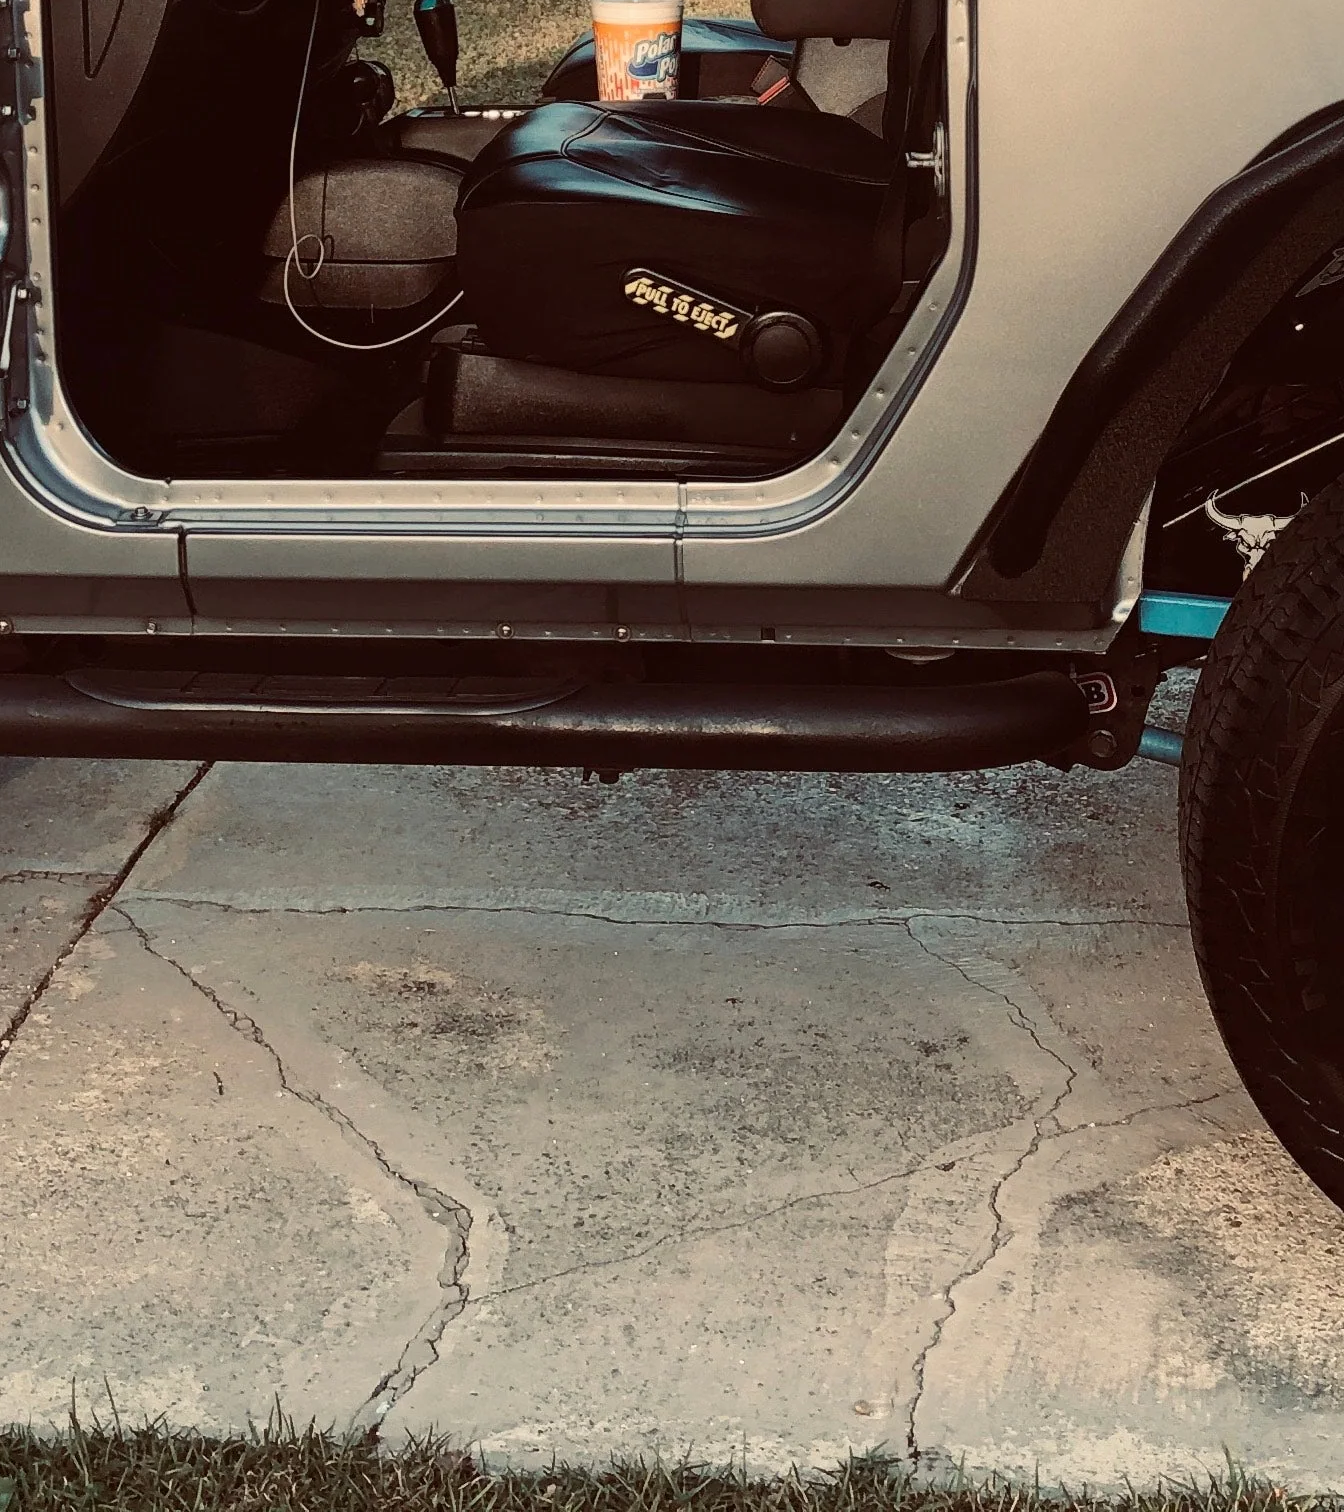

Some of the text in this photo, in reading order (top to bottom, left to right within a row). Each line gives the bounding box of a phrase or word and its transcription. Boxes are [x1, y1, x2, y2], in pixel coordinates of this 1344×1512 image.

[636, 33, 677, 63] Polar
[635, 279, 731, 333] PULL TO EJECT
